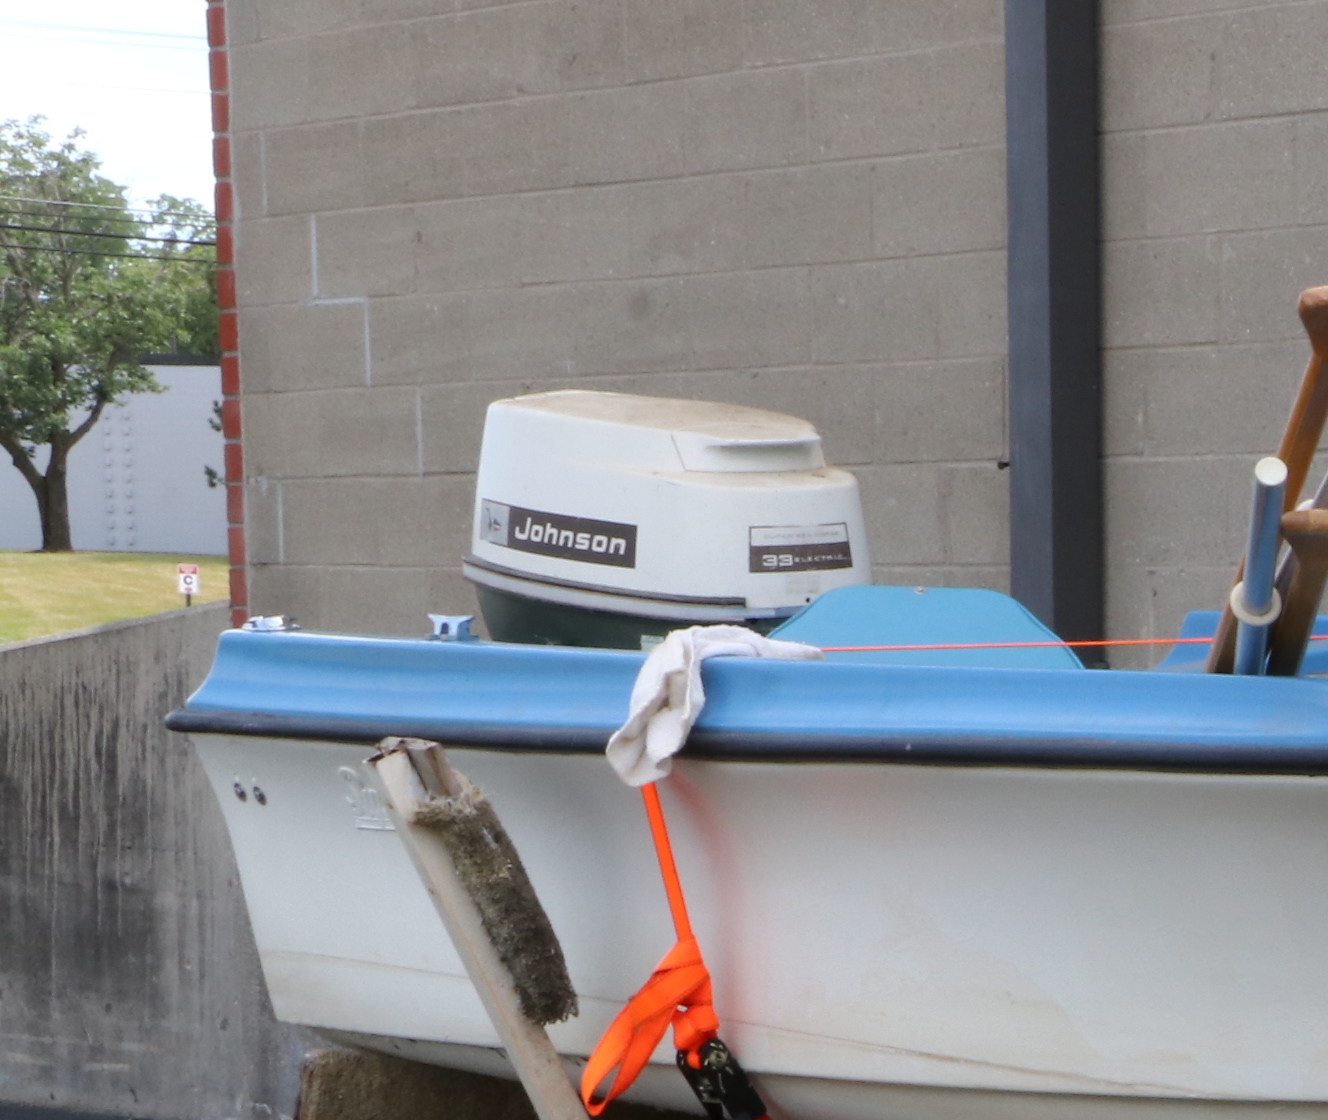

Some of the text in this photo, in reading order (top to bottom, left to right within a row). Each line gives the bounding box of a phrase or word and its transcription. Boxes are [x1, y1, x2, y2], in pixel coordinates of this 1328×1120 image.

[514, 517, 627, 555] Johnson
[762, 554, 793, 567] 33
[183, 575, 193, 585] C
